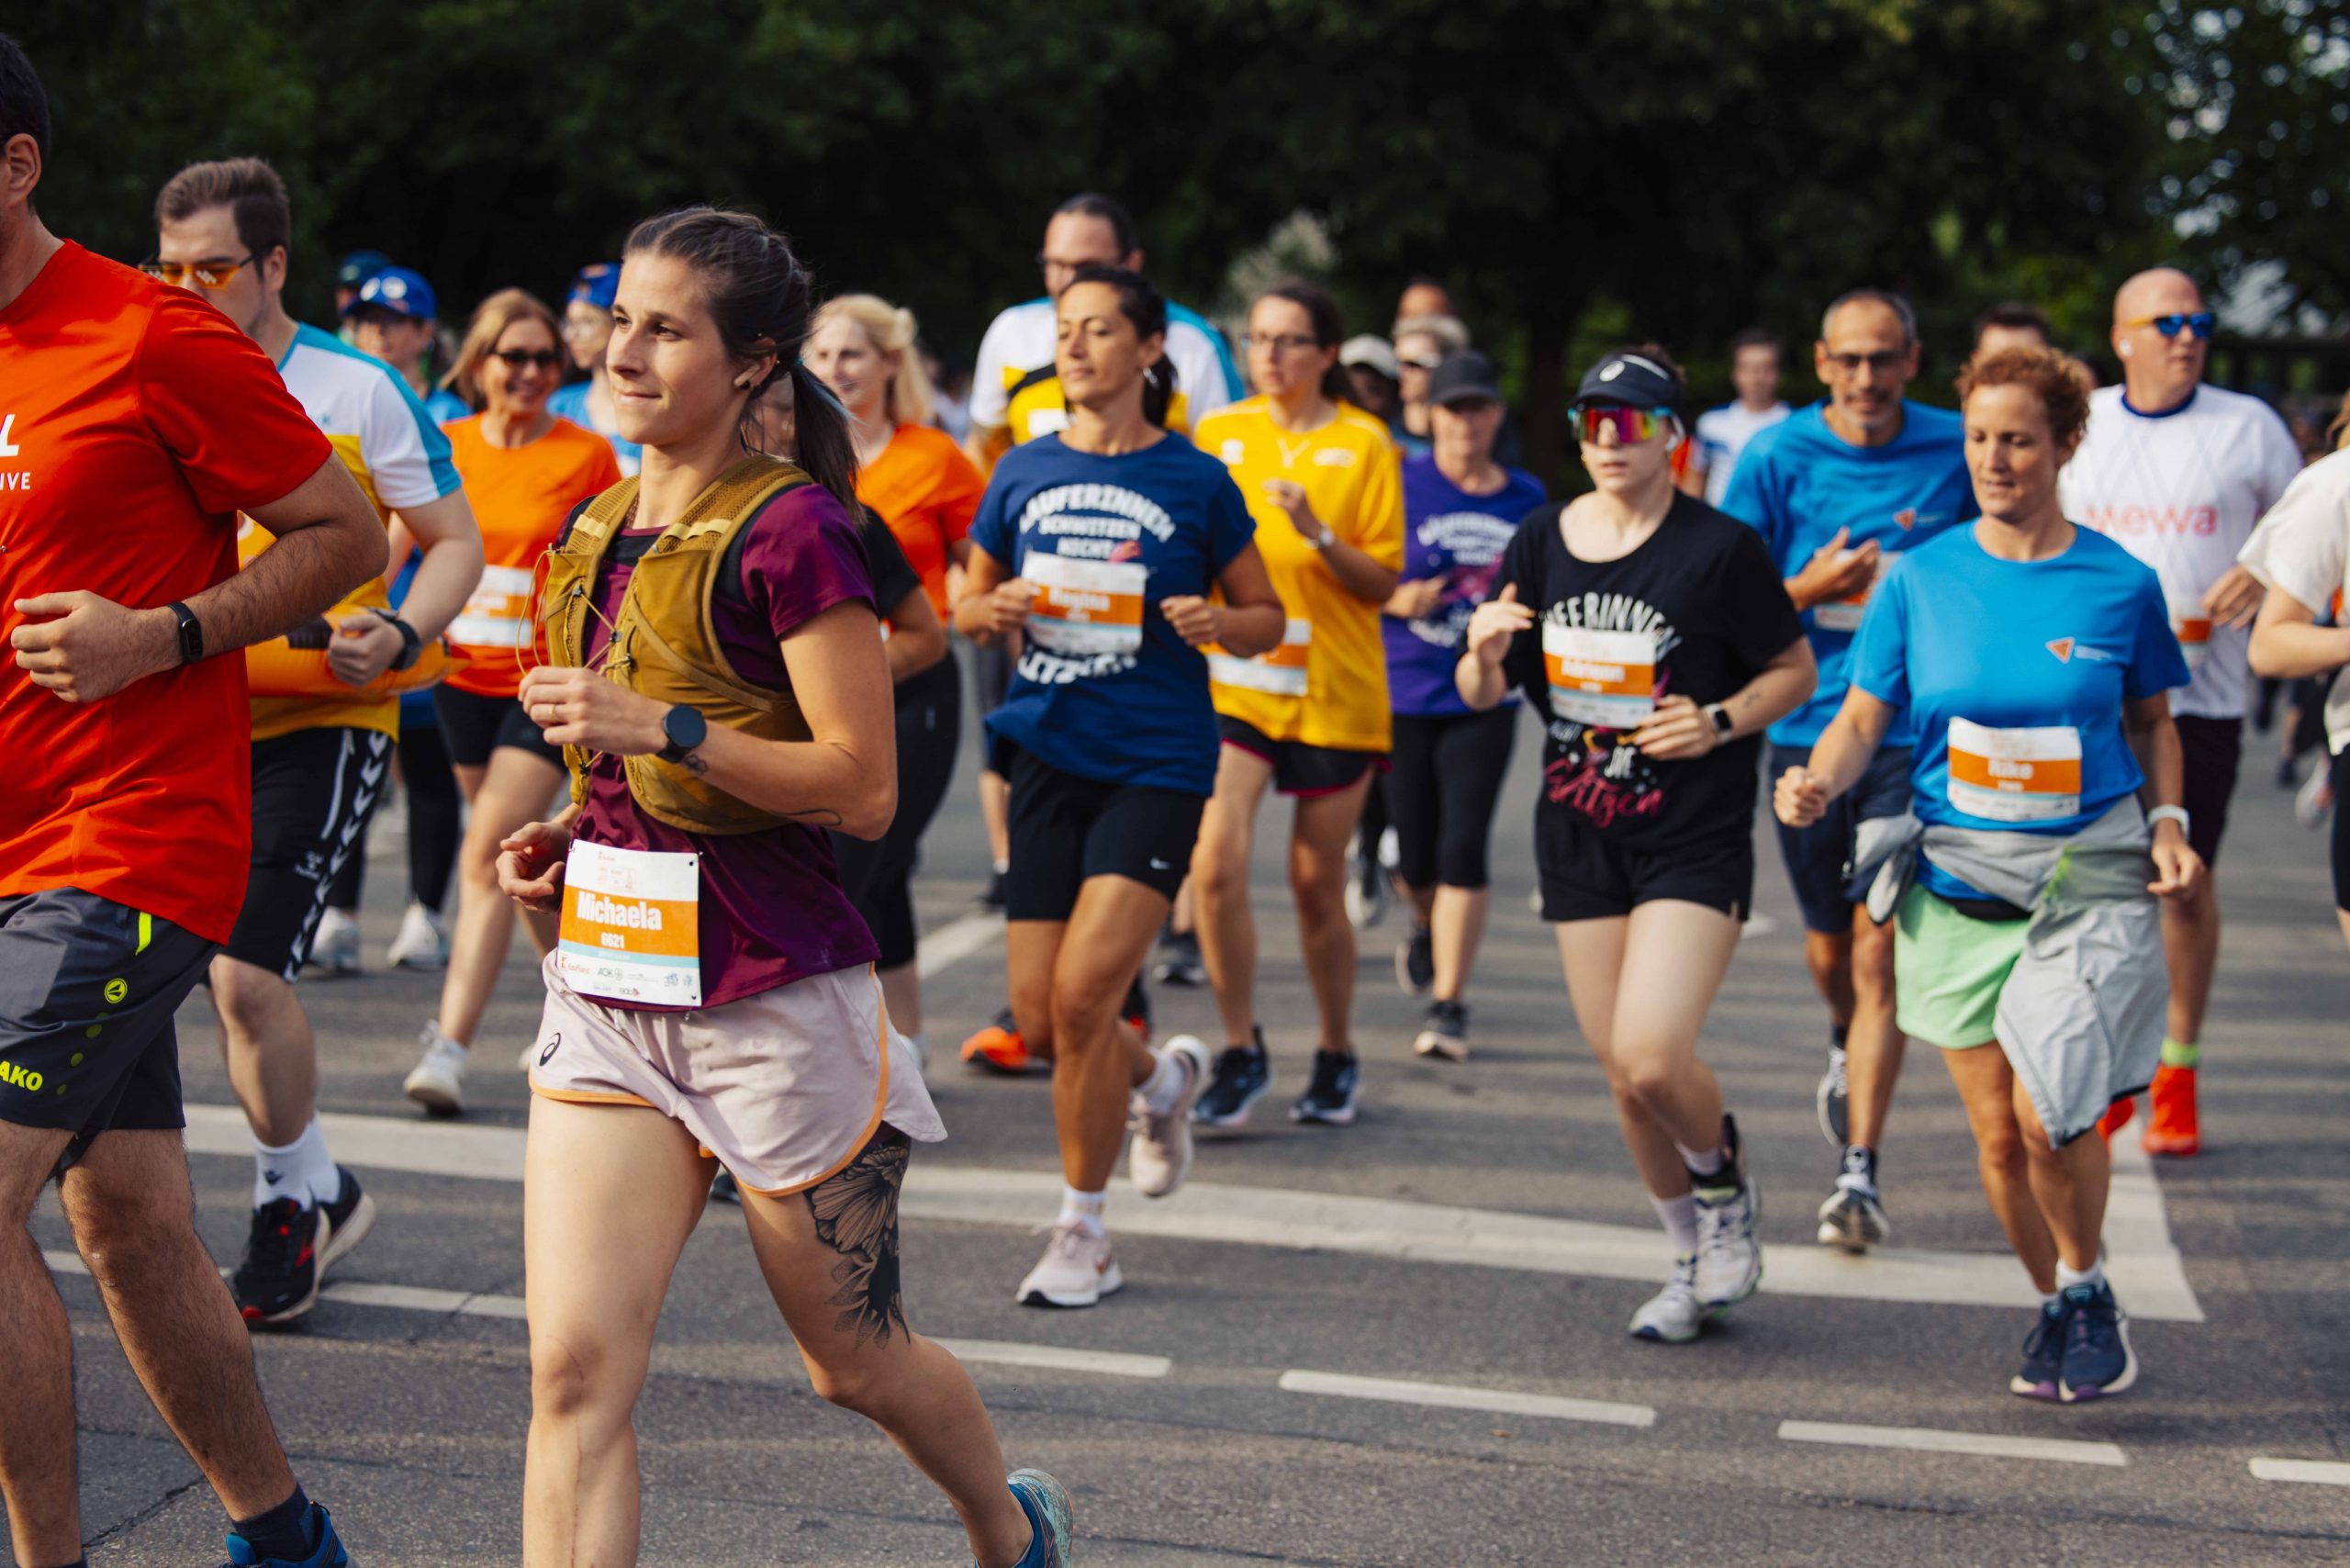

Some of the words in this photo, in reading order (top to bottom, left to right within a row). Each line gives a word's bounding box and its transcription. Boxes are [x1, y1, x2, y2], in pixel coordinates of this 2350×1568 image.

[0, 472, 30, 490] IVE
[576, 890, 663, 931] Michaela
[0, 1060, 43, 1092] AKO
